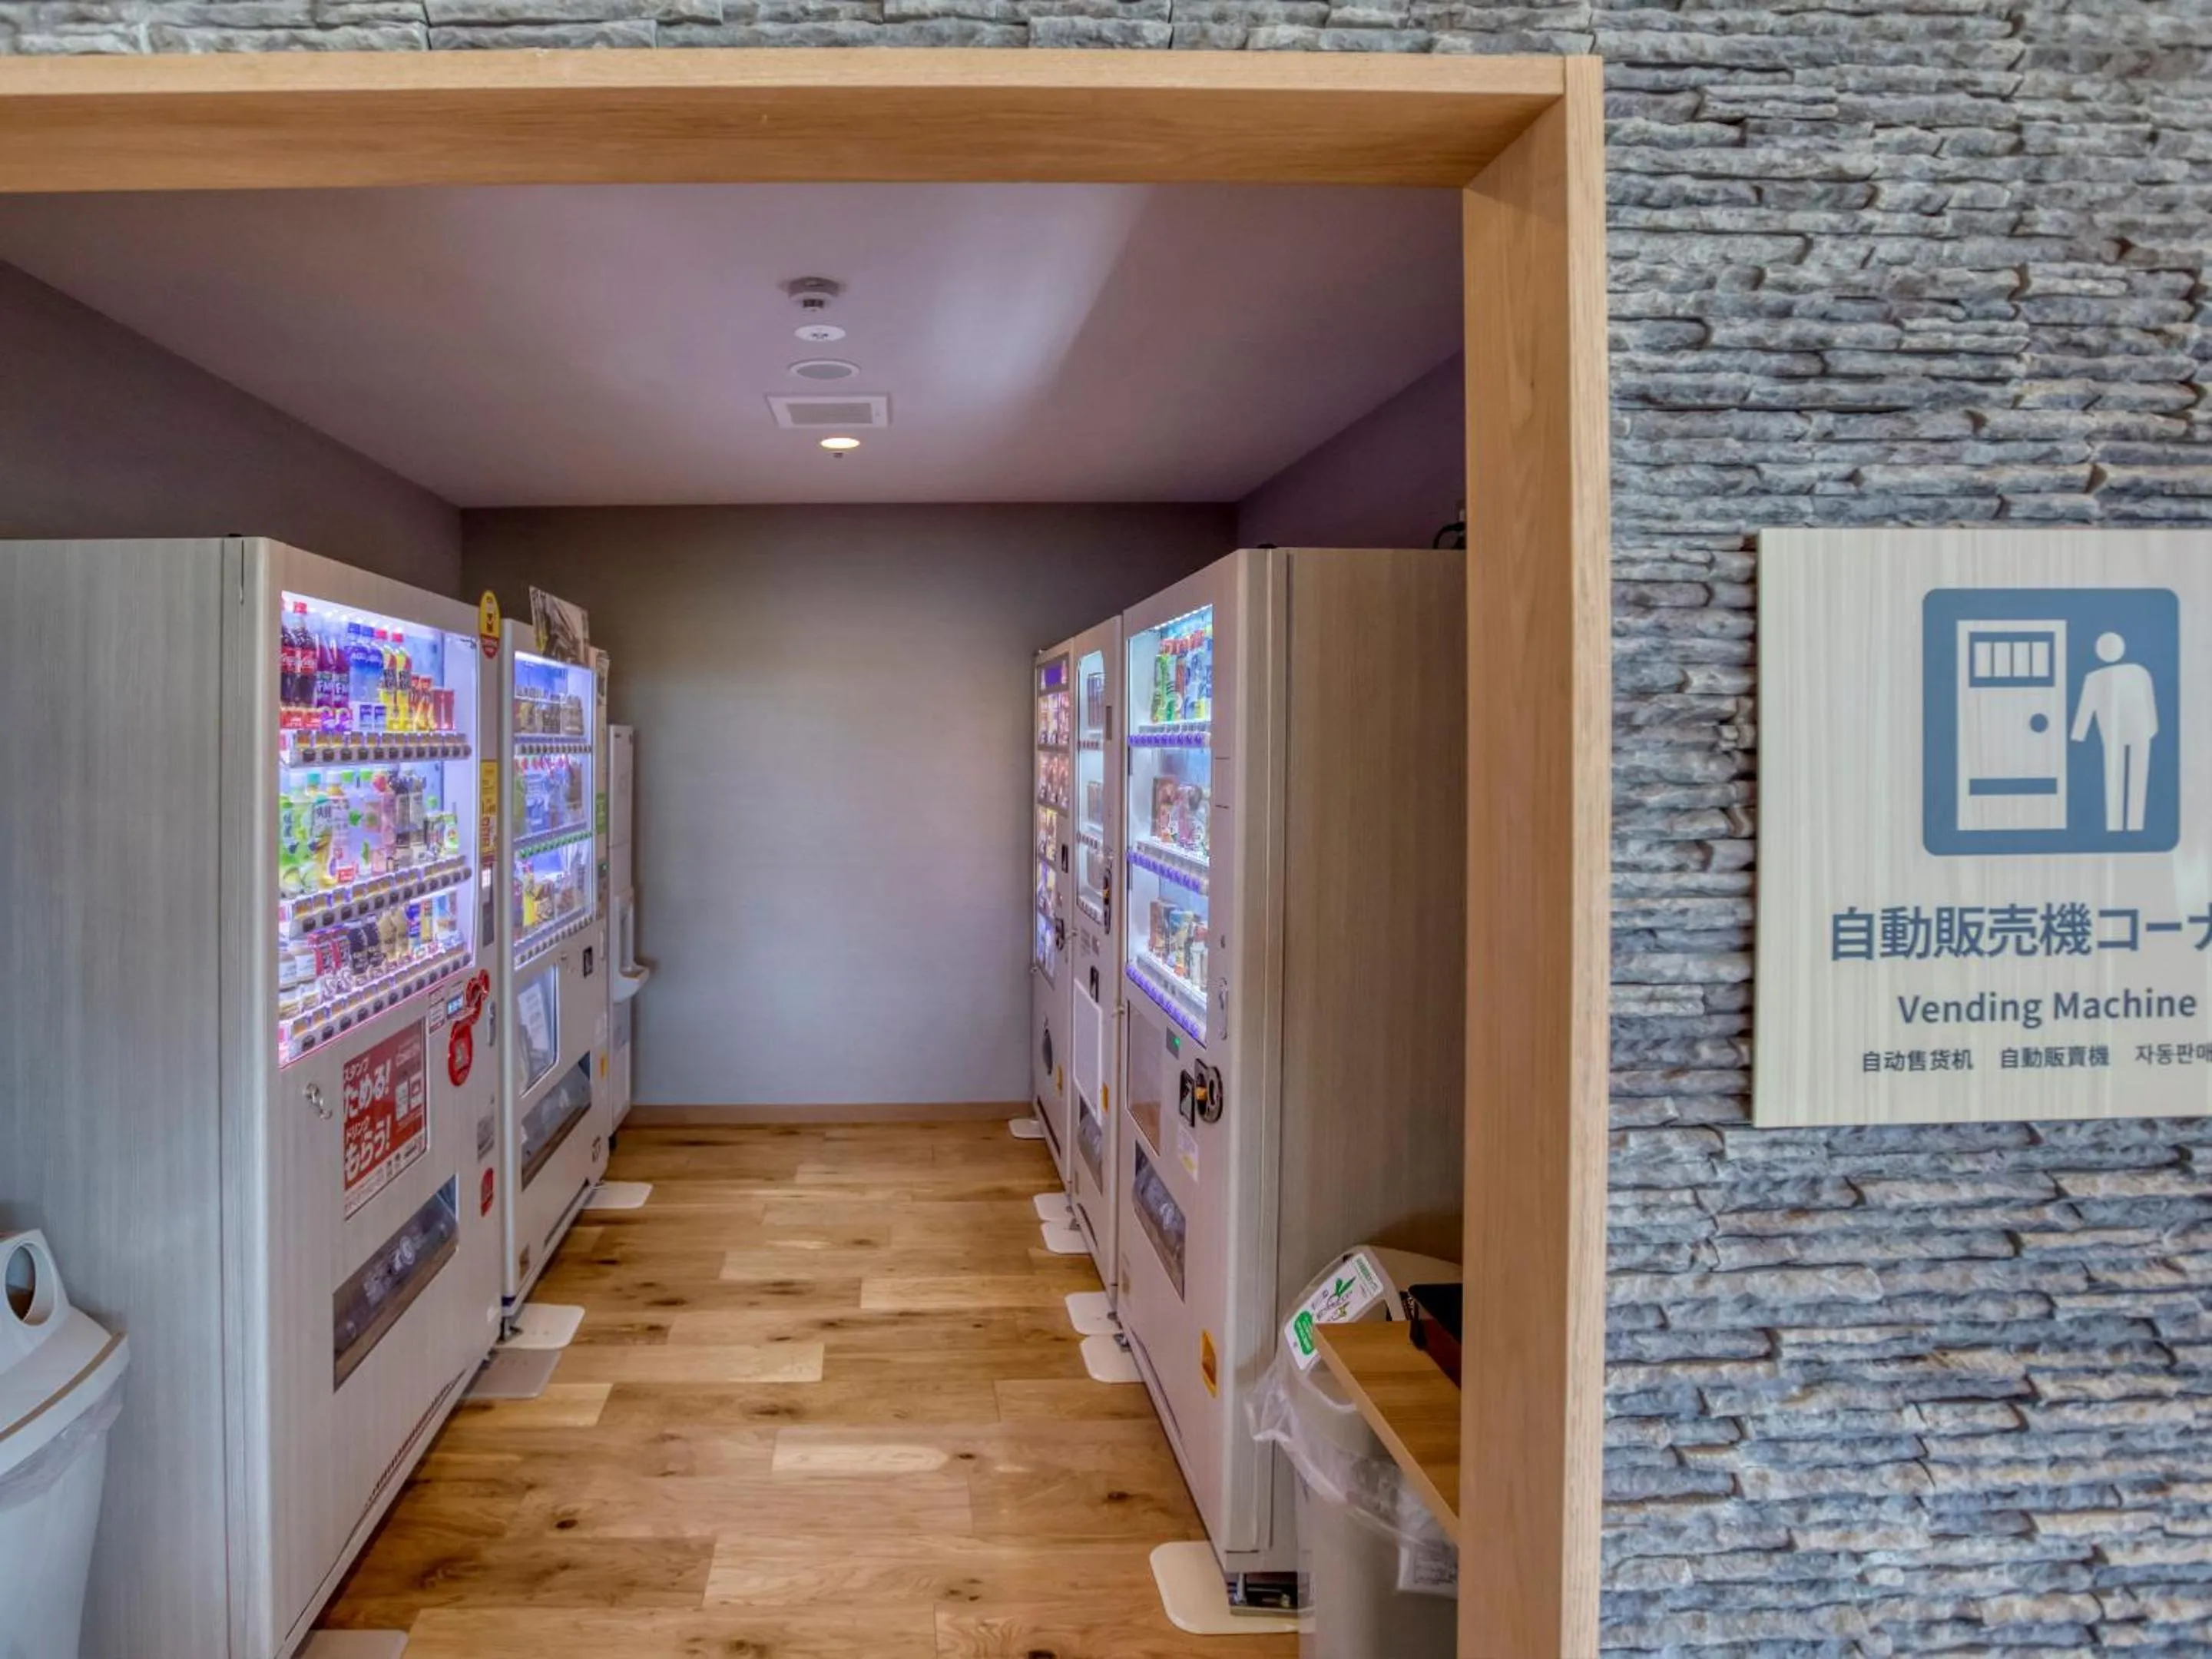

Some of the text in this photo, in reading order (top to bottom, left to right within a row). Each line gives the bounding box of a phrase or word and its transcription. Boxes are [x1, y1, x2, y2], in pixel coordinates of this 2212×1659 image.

[1897, 988, 2197, 1029] Vending Machine
[1863, 1048, 1973, 1073] 自动售货机
[2000, 1045, 2110, 1068] 自動販賣機
